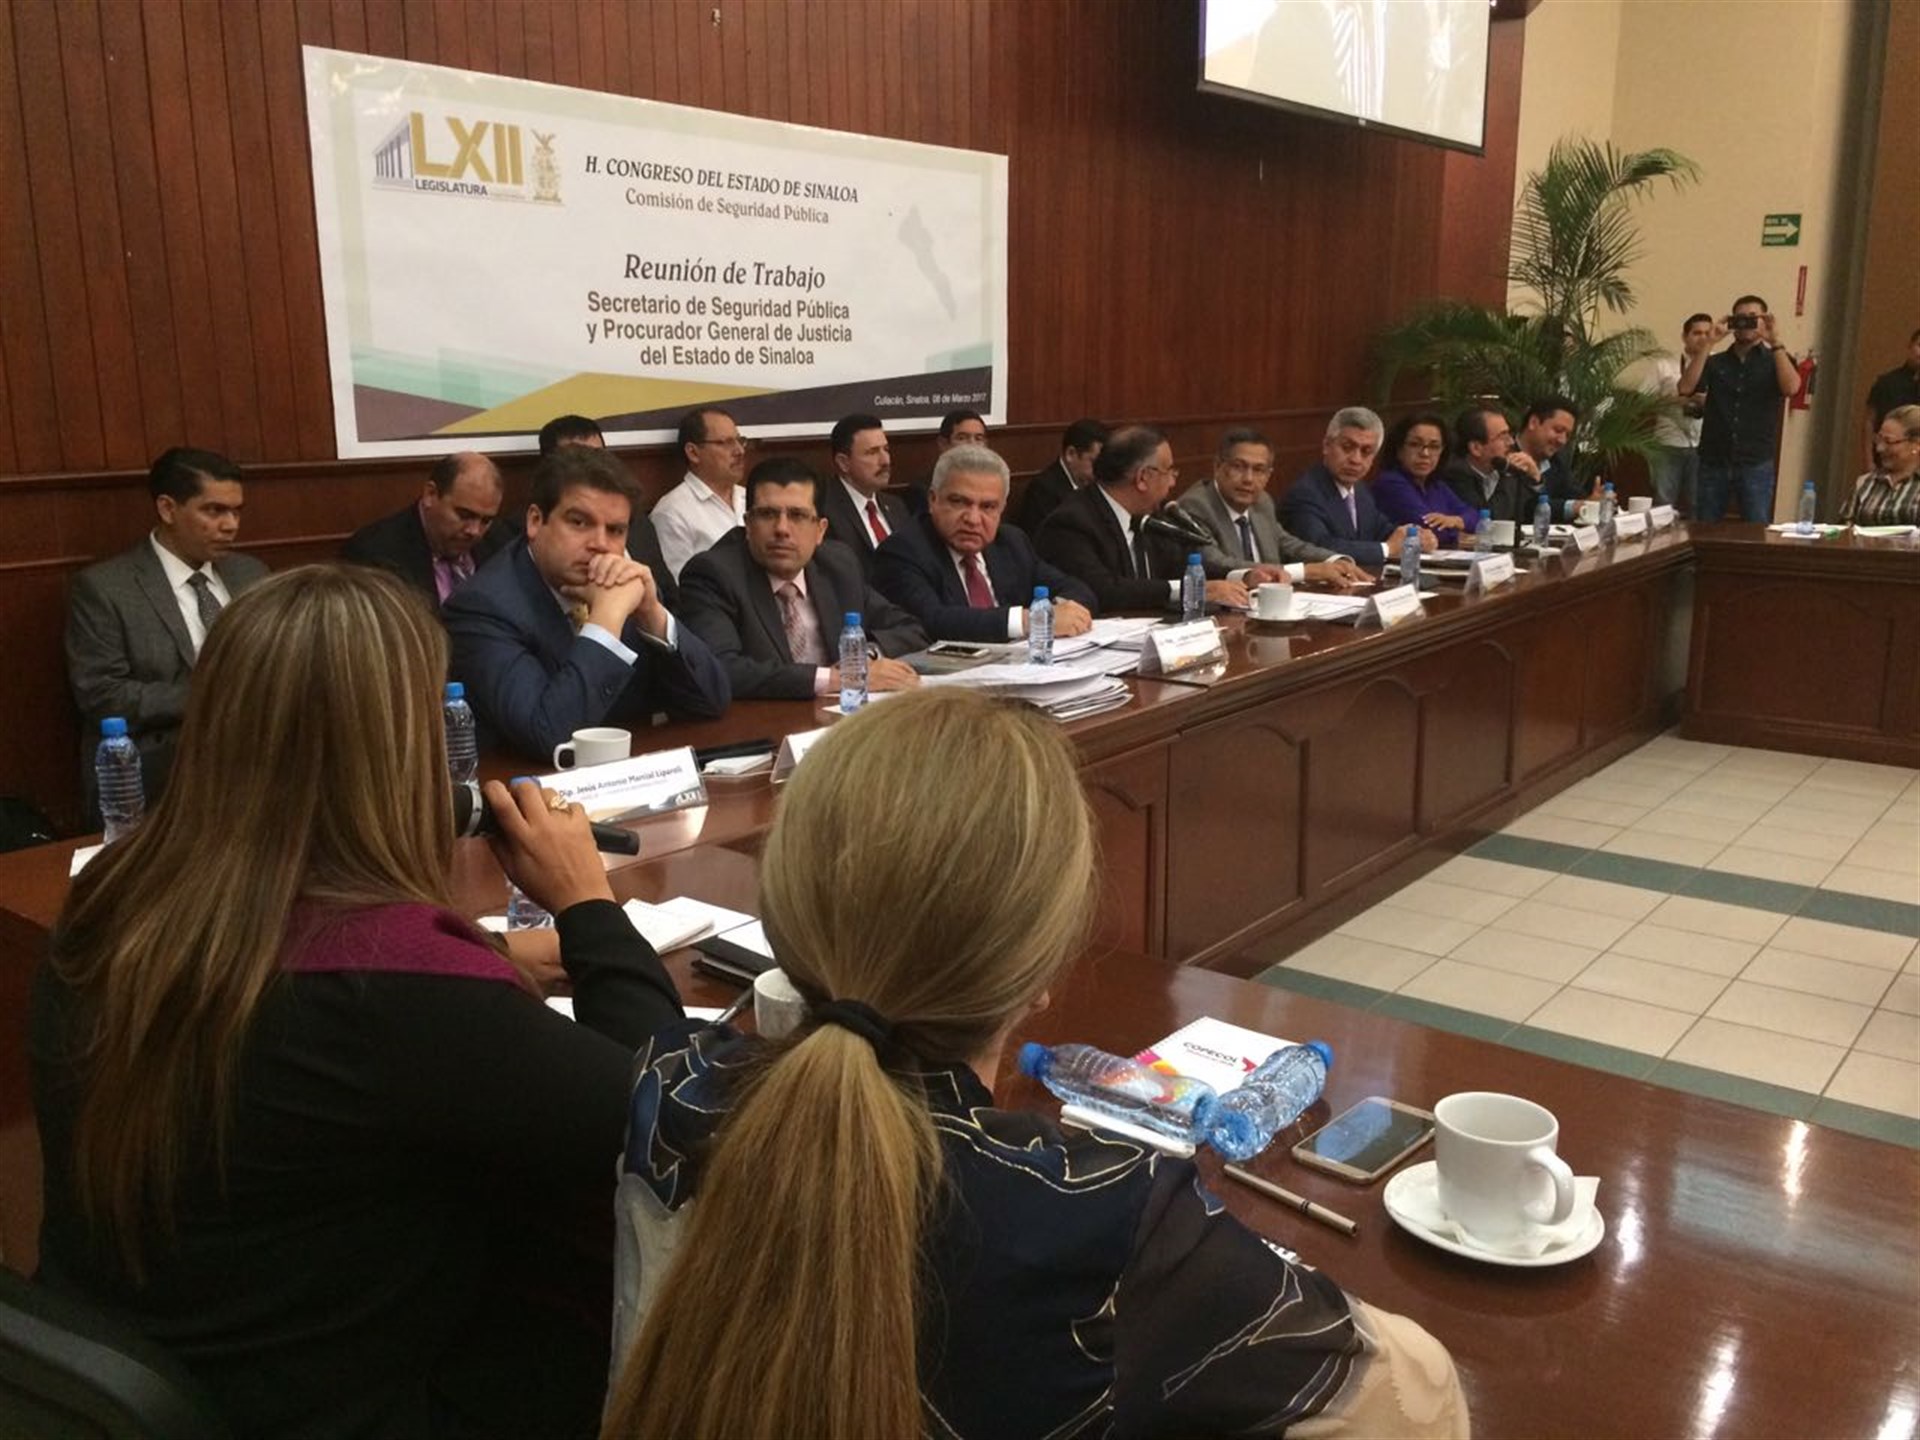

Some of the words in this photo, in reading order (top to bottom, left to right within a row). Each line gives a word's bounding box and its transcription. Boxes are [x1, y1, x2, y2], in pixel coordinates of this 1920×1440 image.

[411, 112, 523, 185] LXII
[415, 179, 488, 196] LEGISLATURA
[585, 155, 601, 174] H.
[606, 158, 694, 185] CONGRESO
[697, 169, 724, 189] DEL
[727, 173, 780, 195] ESTADO
[783, 179, 801, 197] DE
[804, 182, 859, 203] SINALOA
[625, 187, 694, 211] Comisión
[697, 196, 714, 213] de
[717, 197, 780, 219] Seguridad
[784, 204, 829, 224] Pública
[624, 253, 717, 283] Reunión
[723, 261, 747, 285] de
[753, 262, 826, 293] Trabajo
[587, 291, 681, 316] Secretario
[686, 296, 707, 316] de
[711, 296, 792, 321] Seguridad
[797, 299, 850, 319] Pública
[586, 322, 597, 344] y
[603, 318, 702, 340] Procurador
[707, 321, 770, 341] General
[774, 323, 793, 341] de
[797, 323, 853, 342] Justicia
[640, 345, 668, 365] del
[673, 345, 731, 365] Estado
[734, 346, 754, 365] de
[759, 346, 815, 365] Sinaloa
